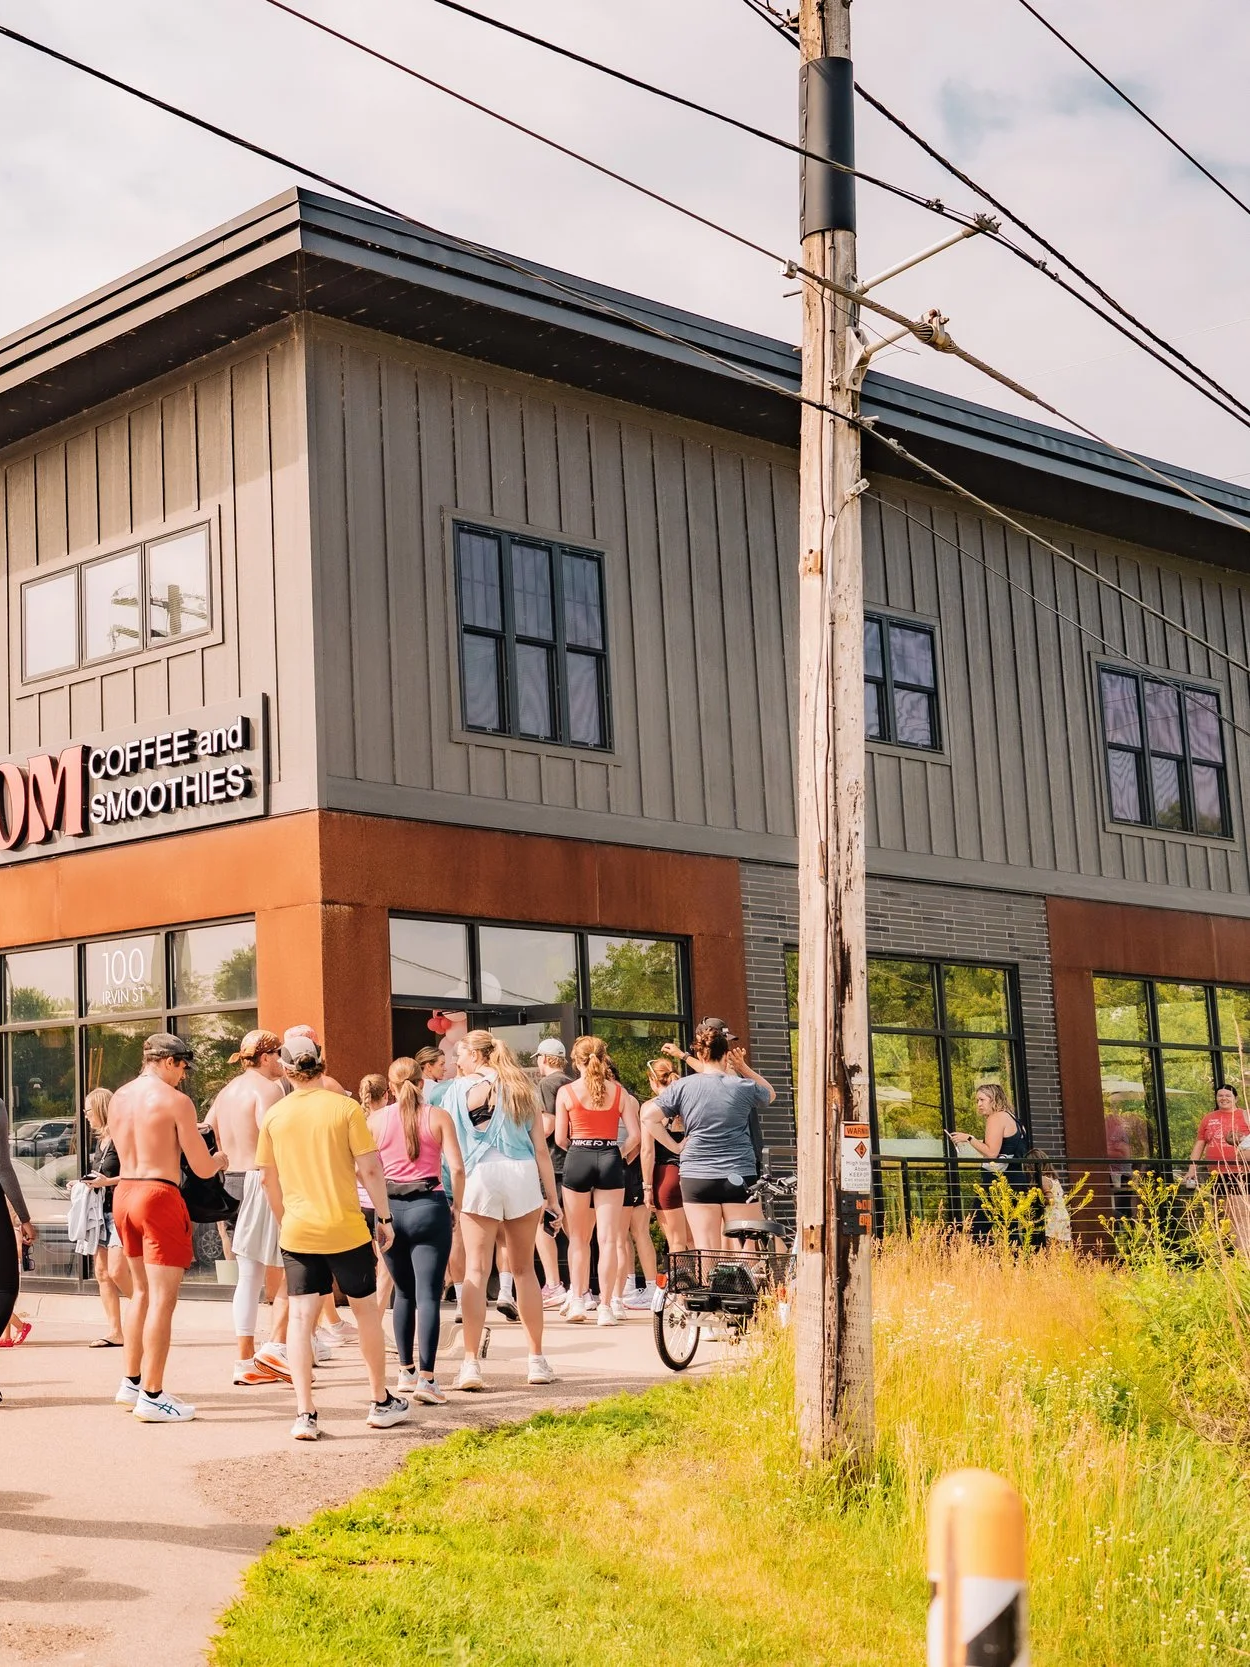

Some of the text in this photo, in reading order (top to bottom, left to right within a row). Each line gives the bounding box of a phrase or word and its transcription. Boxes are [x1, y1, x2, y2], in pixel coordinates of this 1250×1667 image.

[88, 715, 246, 780] COFFEE and
[89, 763, 247, 824] SMOOTHIES
[102, 947, 144, 985] 100
[102, 986, 145, 1006] IRVIN ST
